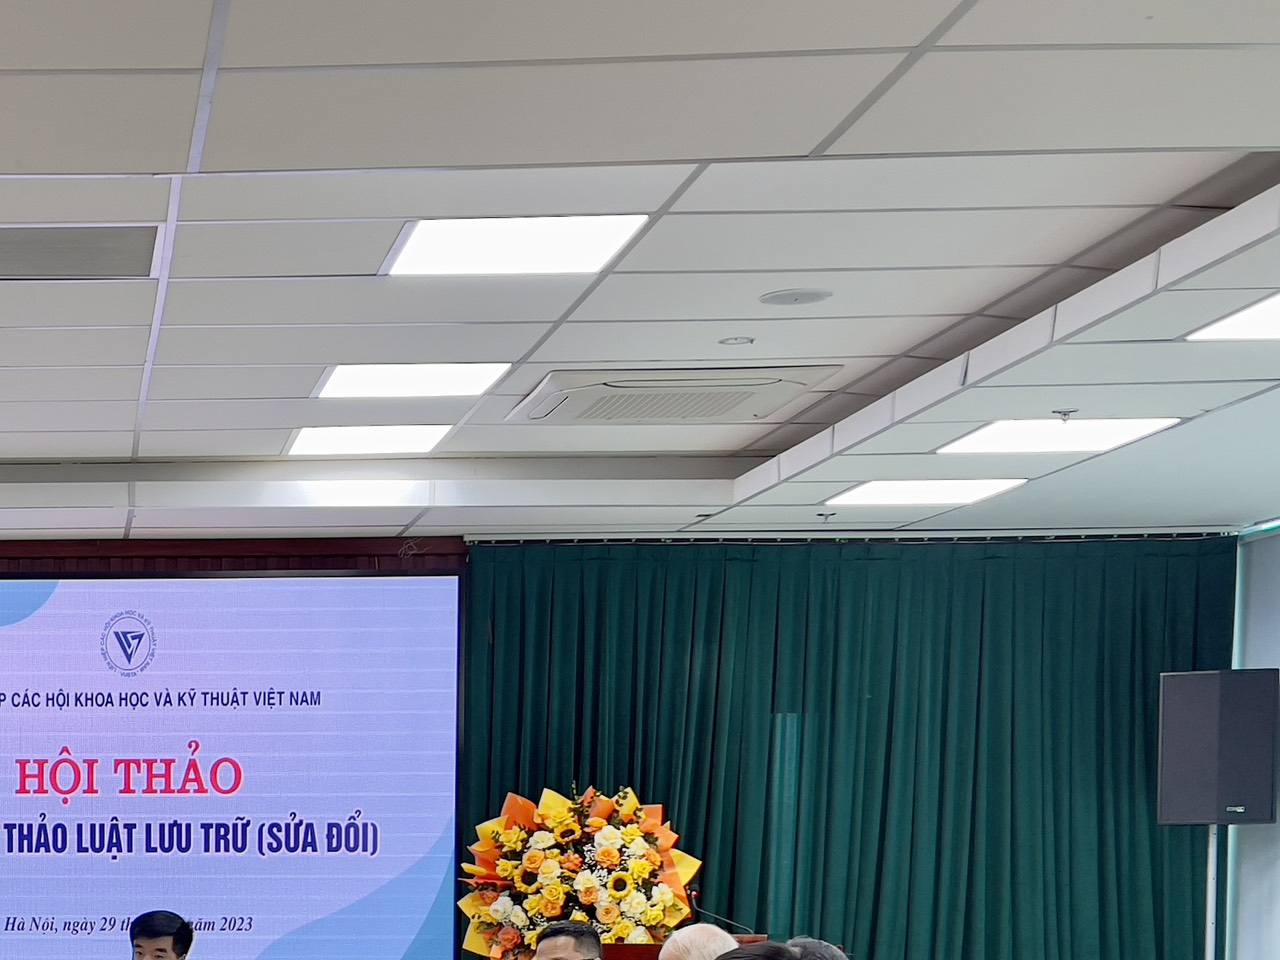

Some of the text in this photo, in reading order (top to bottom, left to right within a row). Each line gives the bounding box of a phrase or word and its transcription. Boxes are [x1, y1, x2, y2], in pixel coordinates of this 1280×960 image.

[11, 688, 41, 707] CÁC
[46, 688, 70, 711] HỘI
[74, 692, 114, 707] KHOA
[119, 691, 149, 710] HỌC
[154, 687, 172, 707] VÀ
[177, 687, 196, 707] KỸ
[201, 687, 249, 709] THUẬT
[253, 687, 285, 709] VIỆT
[289, 691, 321, 706] NAM
[15, 739, 242, 805] HỘI THẢO
[3, 813, 68, 853] THẢO
[76, 816, 137, 860] LUẬT
[145, 820, 192, 853] LƯU
[200, 816, 251, 853] TRỮ
[257, 812, 318, 857] (SỬA
[325, 809, 378, 857] ĐỔI)
[4, 917, 25, 931] Hà
[29, 917, 58, 935] Nội,
[62, 917, 96, 935] ngày
[99, 917, 117, 931] 29
[219, 917, 253, 931] 2023
